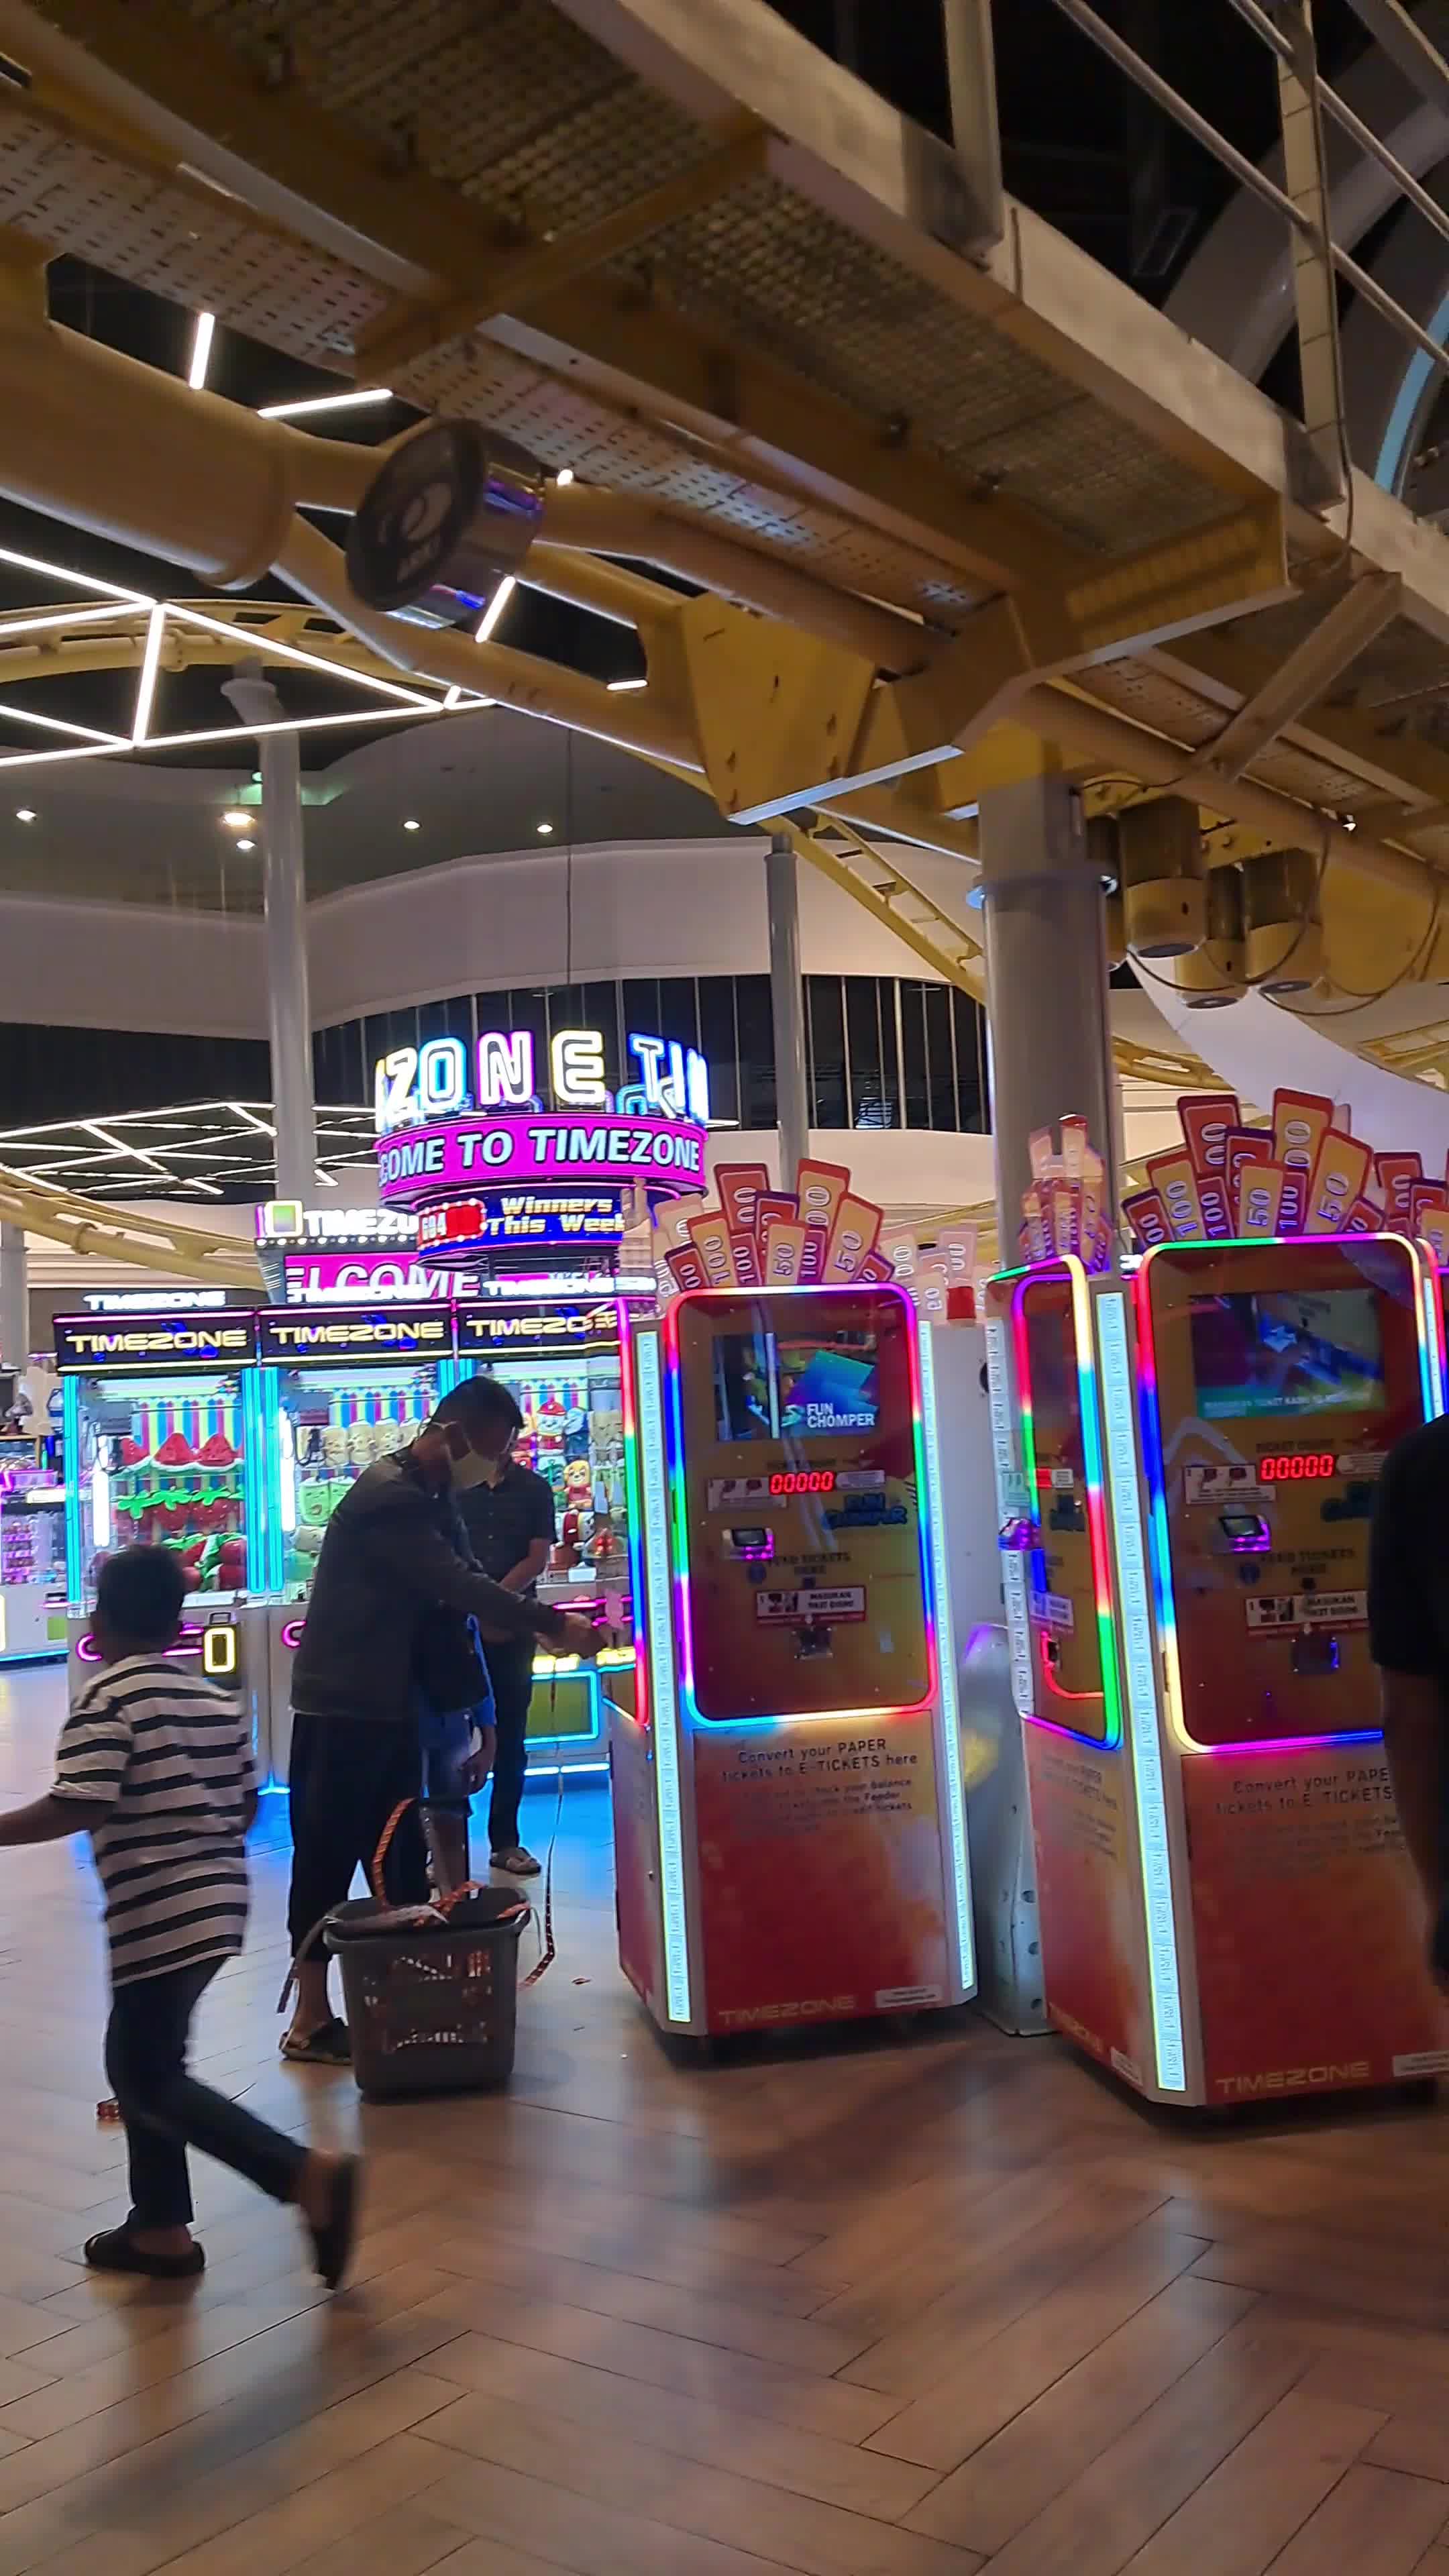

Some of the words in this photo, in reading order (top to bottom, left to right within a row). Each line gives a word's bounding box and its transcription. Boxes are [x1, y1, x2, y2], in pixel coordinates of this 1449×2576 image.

[458, 1131, 513, 1167] TO
[529, 1129, 700, 1171] TIMEZONE
[502, 1197, 613, 1214] Winners
[1167, 1181, 1197, 1236] 100
[1246, 1188, 1271, 1226] 50
[1278, 1186, 1298, 1229] 100
[1317, 1173, 1349, 1222] 50
[487, 1215, 546, 1236] This
[1201, 1192, 1227, 1236] 100
[733, 1246, 755, 1283] 100
[773, 1242, 794, 1276] 50
[800, 1242, 818, 1277] 100
[834, 1230, 863, 1272] 50
[66, 1330, 247, 1353] TIMEZONE
[270, 1321, 444, 1345] TIMEZONE
[807, 1403, 834, 1415] FUN
[807, 1413, 875, 1428] CHOMPER
[1261, 1454, 1334, 1480] 00000
[771, 1471, 834, 1494] 00000
[739, 1748, 795, 1764] Convert
[801, 1746, 832, 1760] your
[839, 1738, 887, 1754] PAPER
[886, 1754, 918, 1765] here
[1233, 1777, 1297, 1794] Convert
[1305, 1775, 1338, 1790] your
[1280, 1797, 1295, 1810] to
[719, 1995, 855, 2025] TIMEZONE
[1216, 2060, 1371, 2094] TIMEZONE
